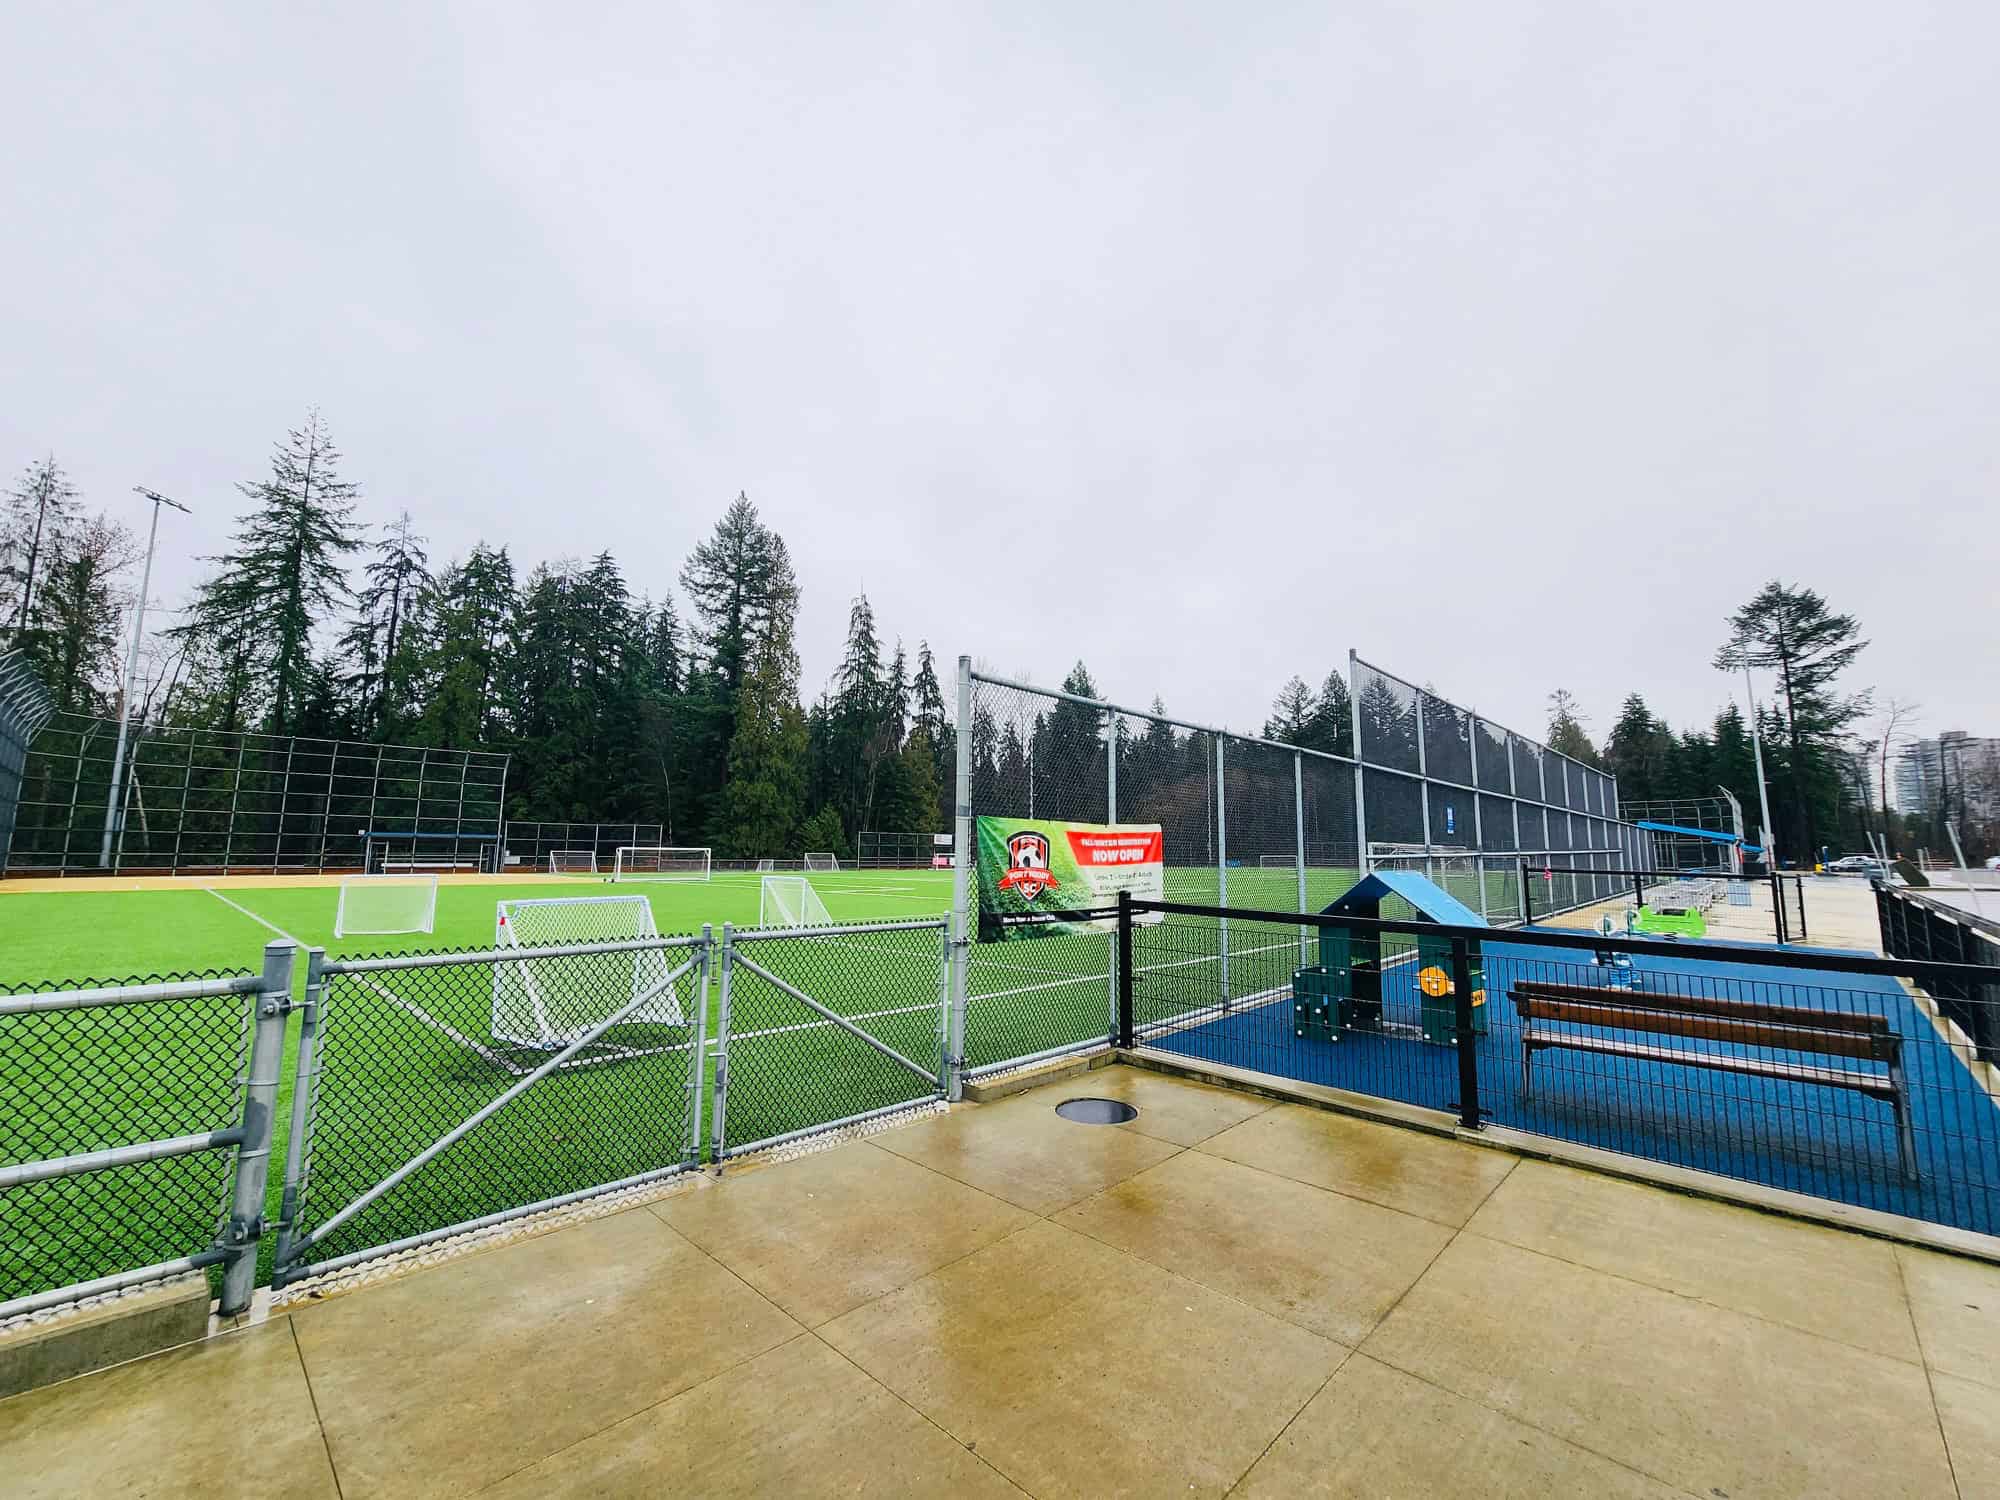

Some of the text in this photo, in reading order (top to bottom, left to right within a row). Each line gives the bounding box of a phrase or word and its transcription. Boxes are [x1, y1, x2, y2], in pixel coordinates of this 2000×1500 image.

[1092, 848, 1145, 862] NOW OPEN
[1008, 869, 1050, 880] PORT MOODY
[1023, 883, 1037, 893] SC
